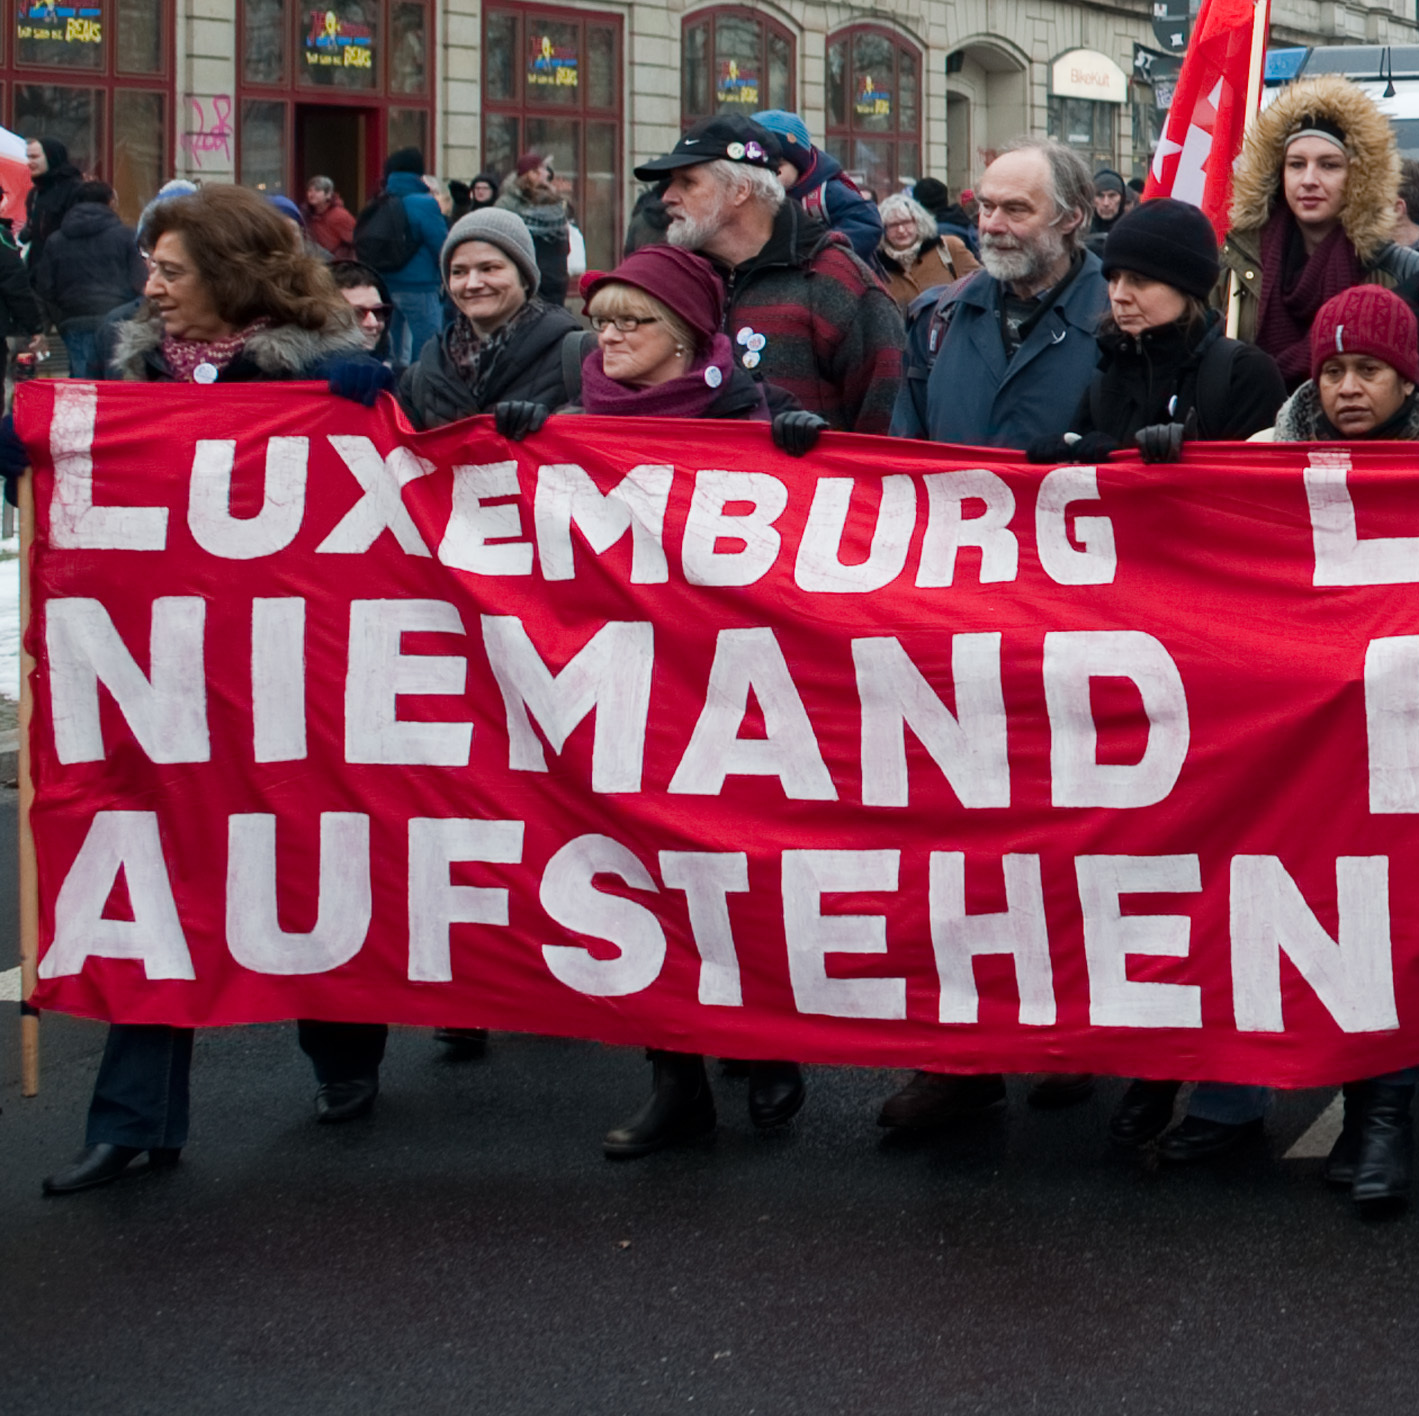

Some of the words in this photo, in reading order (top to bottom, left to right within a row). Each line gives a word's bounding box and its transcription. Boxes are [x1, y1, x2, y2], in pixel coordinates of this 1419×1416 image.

[49, 384, 1117, 593] LUXEMBURG
[45, 595, 1191, 808] NIEMAND
[38, 810, 1400, 1034] AUFSTEHEN
